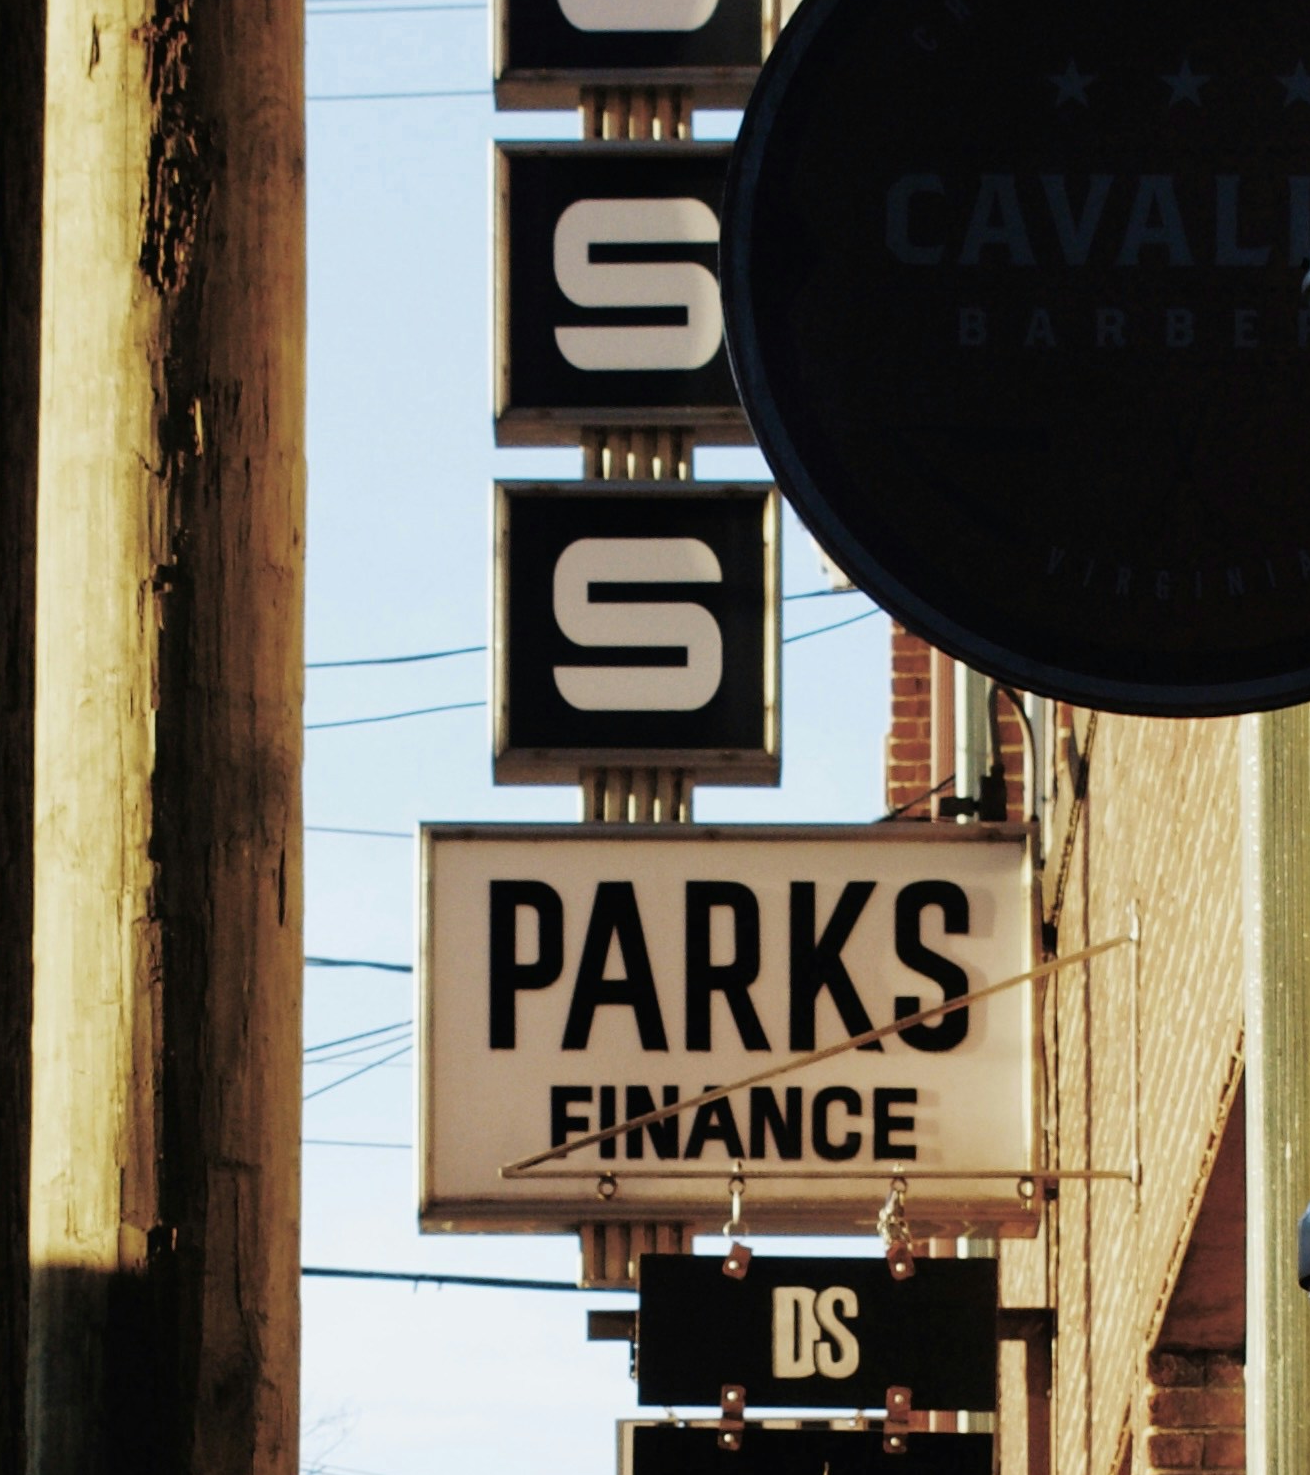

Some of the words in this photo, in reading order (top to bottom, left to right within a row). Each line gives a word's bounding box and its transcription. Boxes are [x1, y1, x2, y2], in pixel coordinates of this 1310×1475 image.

[489, 879, 970, 1052] PARKS
[550, 1086, 918, 1161] FINANCE
[772, 1285, 860, 1380] DS
